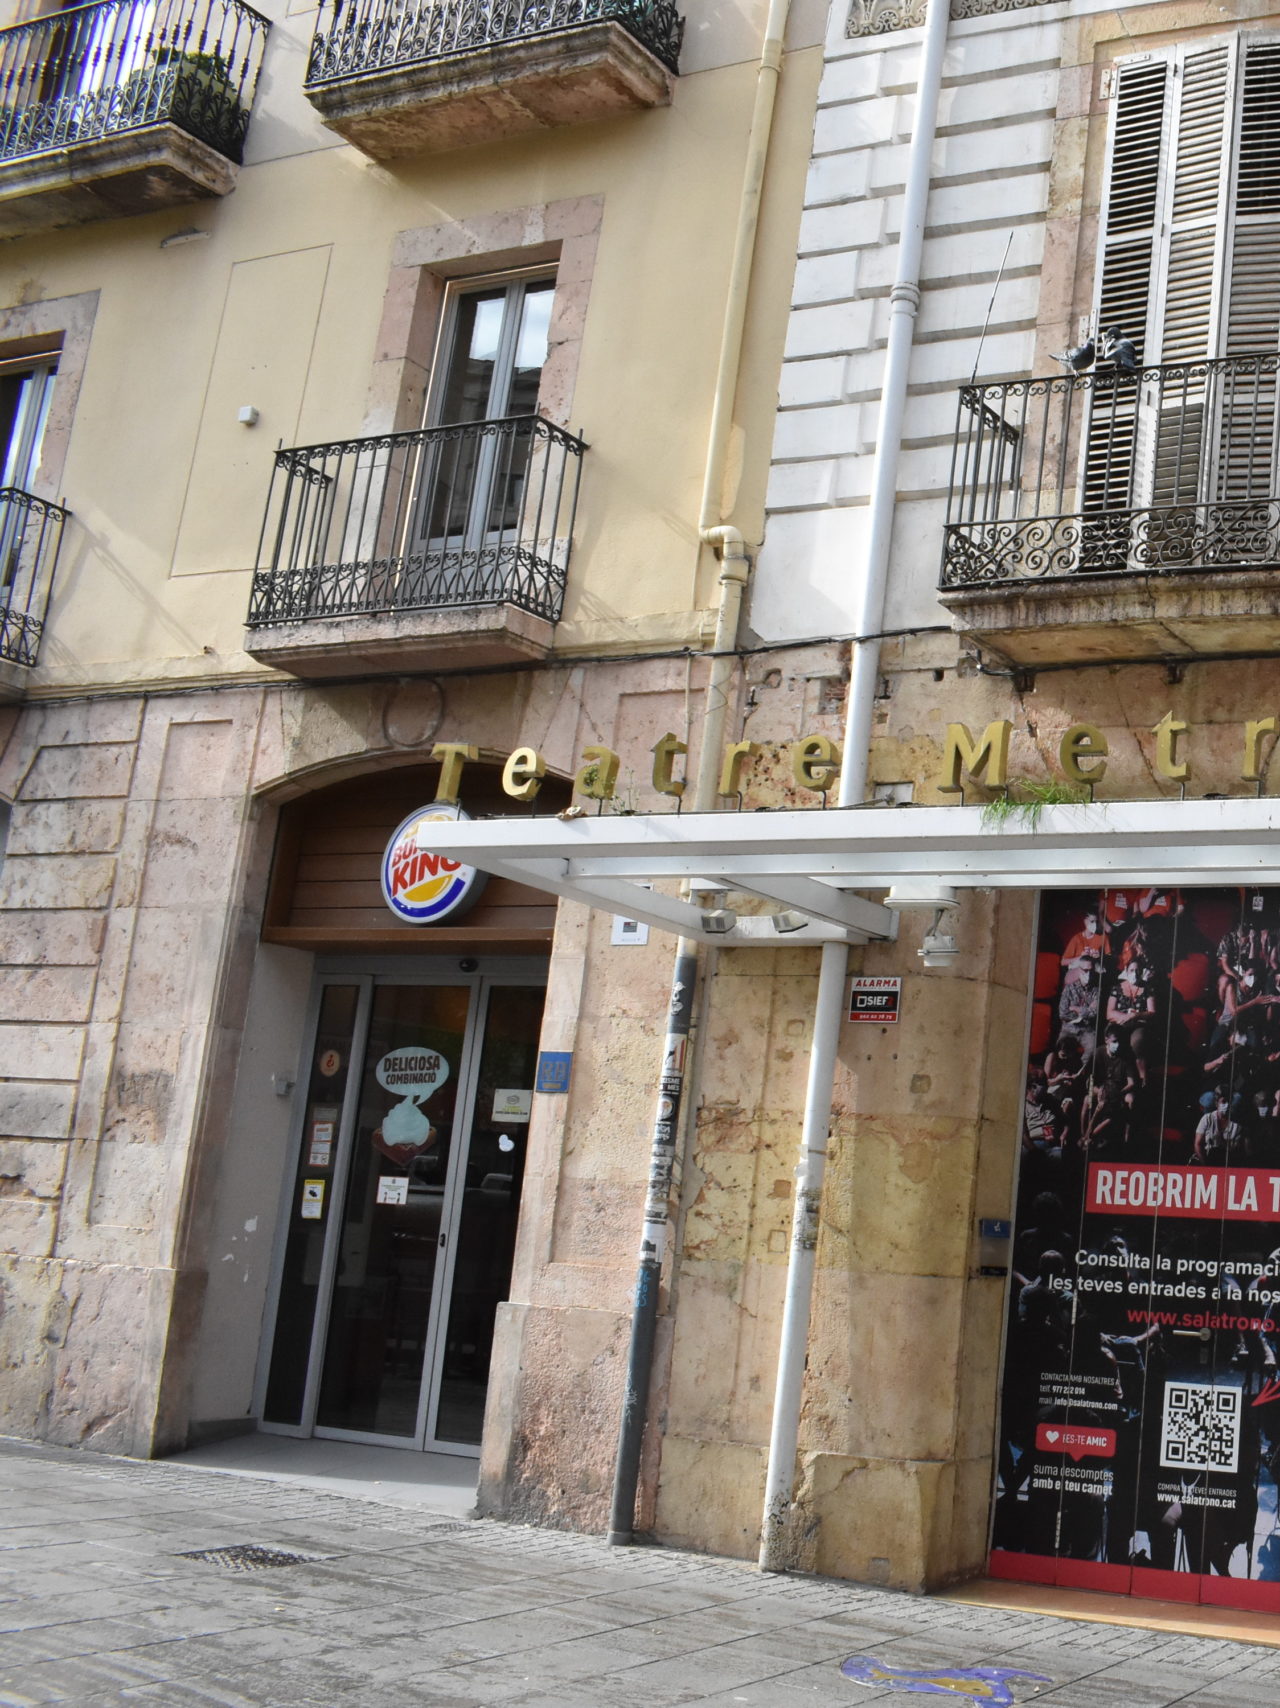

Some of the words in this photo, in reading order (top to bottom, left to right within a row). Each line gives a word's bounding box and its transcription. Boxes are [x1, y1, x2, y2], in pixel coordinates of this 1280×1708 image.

[430, 732, 841, 802] Teatre
[384, 1056, 441, 1072] DELICIOSA
[1096, 1170, 1218, 1210] REOBRIM
[1227, 1175, 1258, 1211] LA
[1075, 1250, 1151, 1270] Consulta
[1156, 1254, 1171, 1270] la
[1048, 1273, 1073, 1290] les
[1077, 1275, 1123, 1293] teves
[1128, 1281, 1206, 1299] entrades
[1211, 1288, 1221, 1300] a
[1227, 1284, 1242, 1301] la
[1040, 1372, 1069, 1382] CONTACTA
[1070, 1374, 1083, 1383] AMB
[1083, 1375, 1115, 1386] NOSALTRES
[1052, 1385, 1063, 1393] 977
[1086, 1435, 1108, 1448] AMIC
[1033, 1464, 1059, 1476] suma
[1032, 1477, 1054, 1489] amb
[1065, 1479, 1081, 1492] teu
[1081, 1482, 1113, 1496] carnet
[1157, 1482, 1181, 1492] COMPRA
[1208, 1487, 1237, 1498] ENTRADES
[1157, 1492, 1236, 1509] www.salatrono.cat
